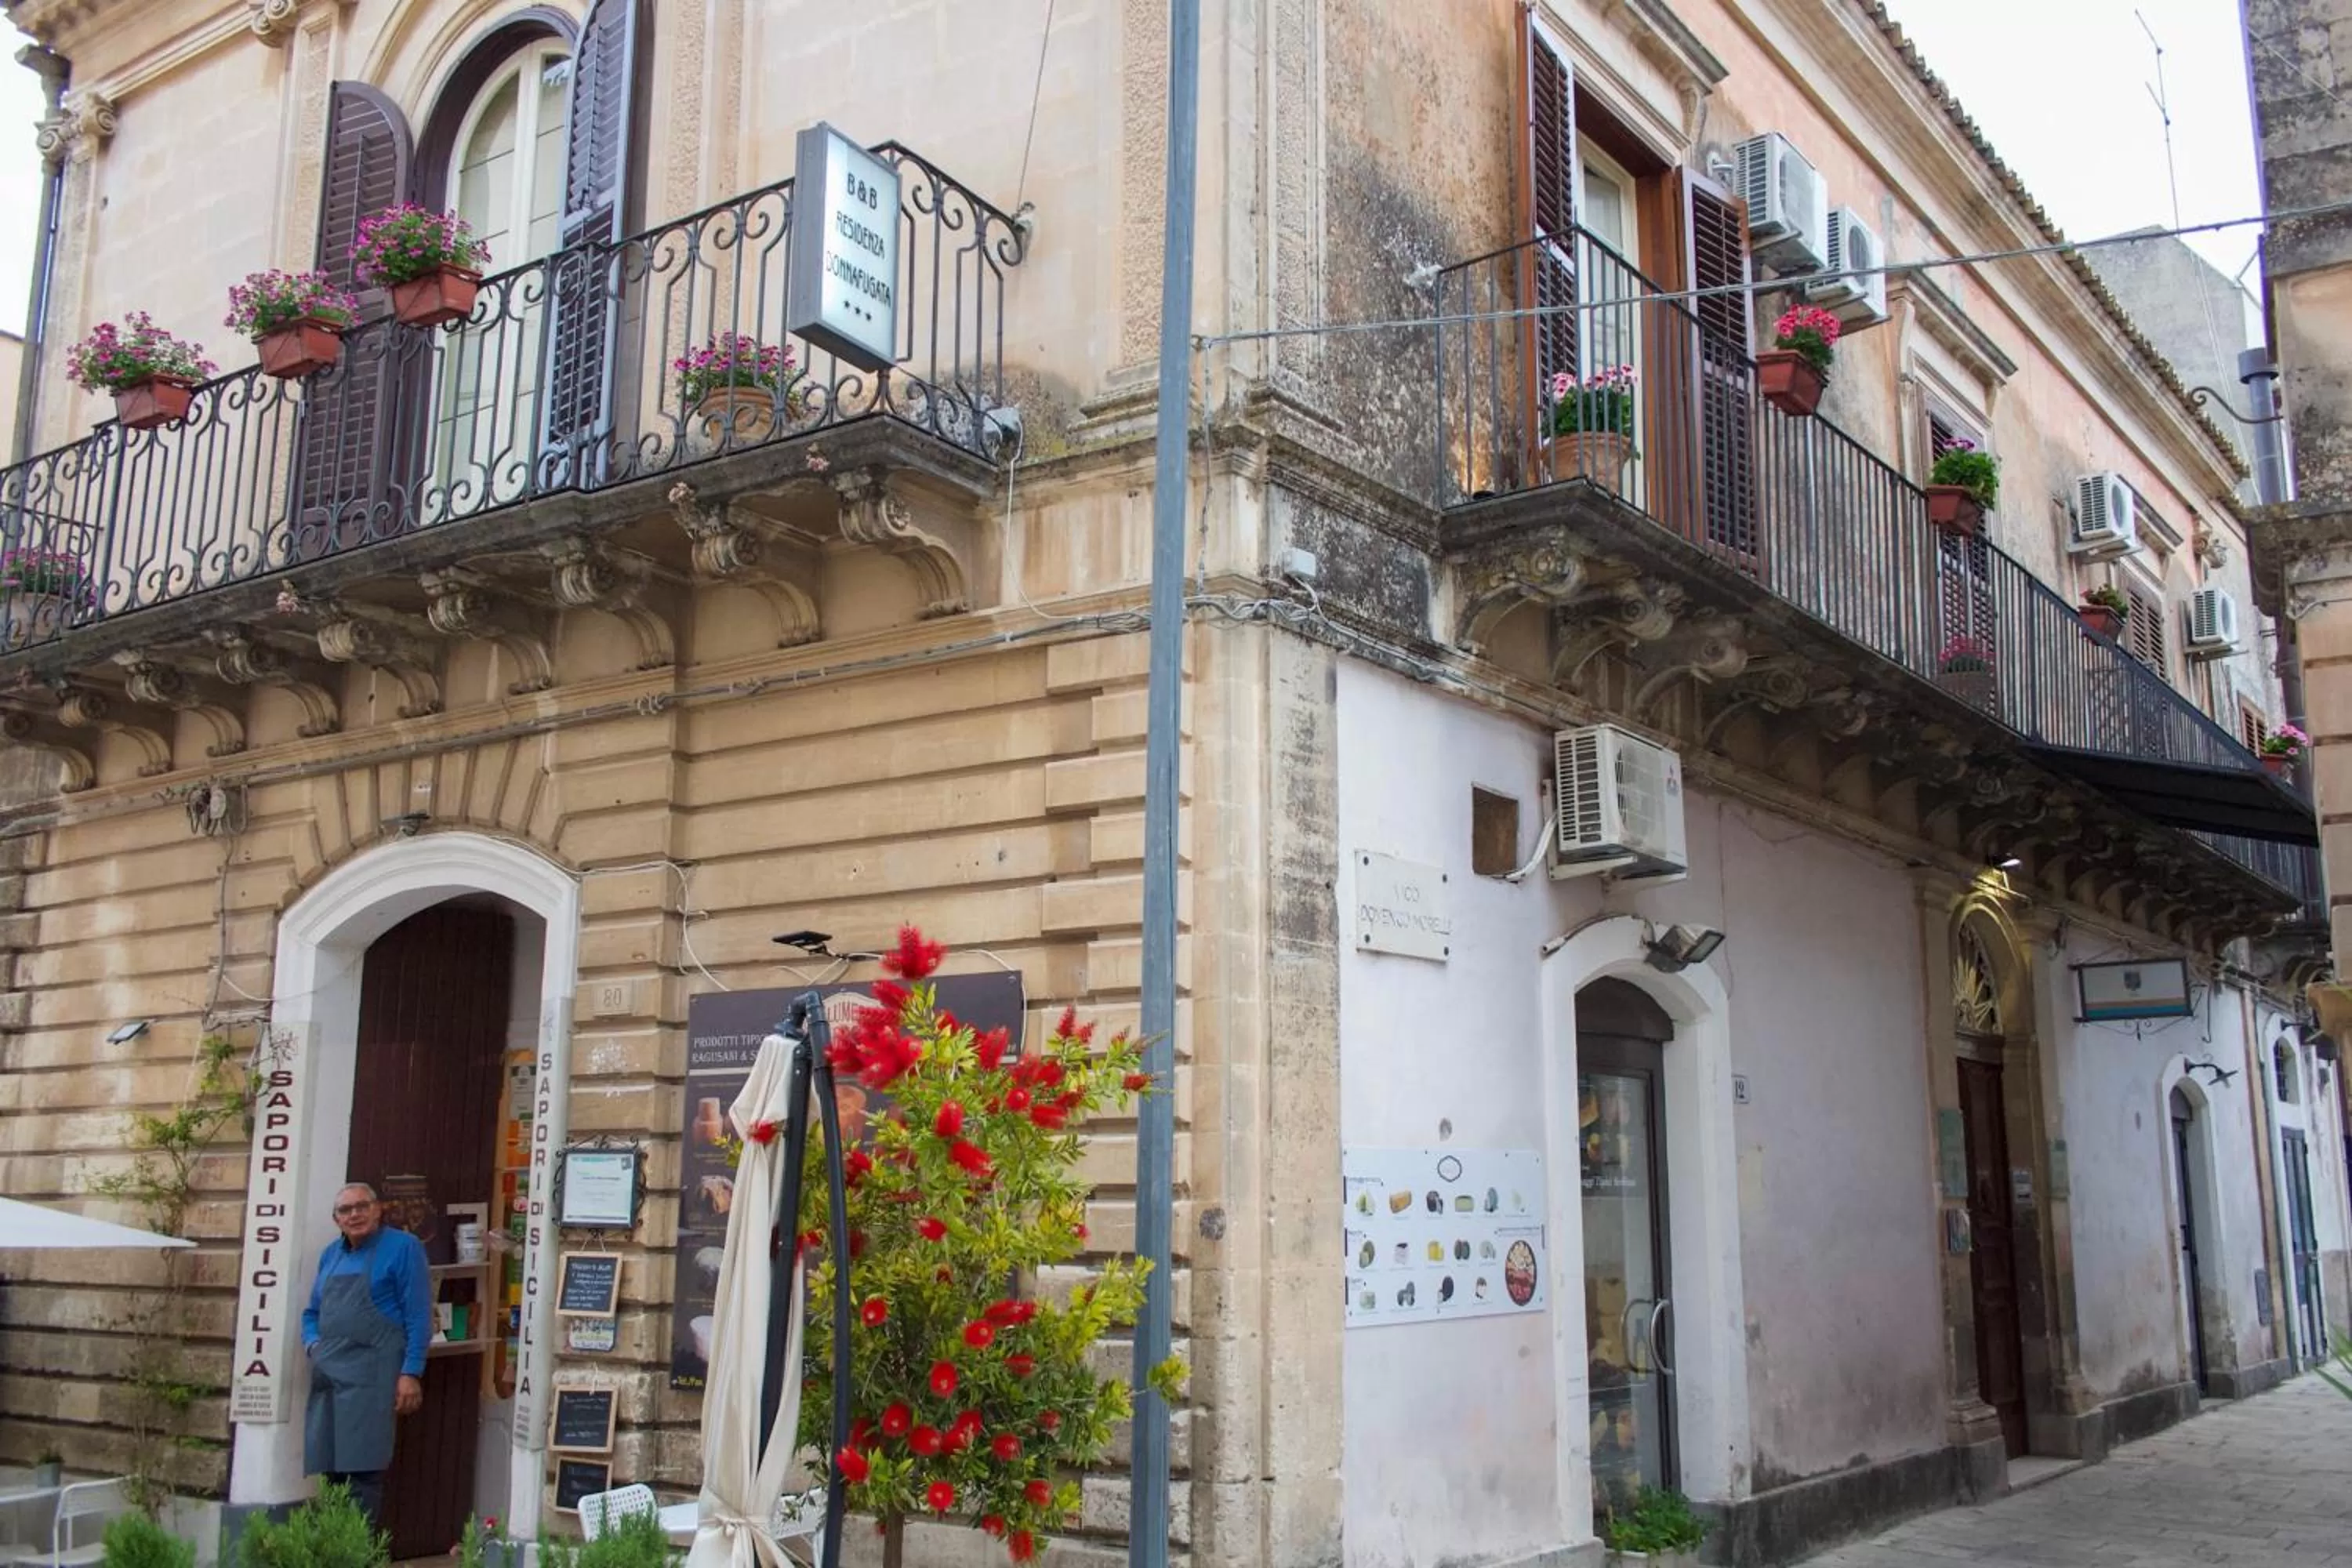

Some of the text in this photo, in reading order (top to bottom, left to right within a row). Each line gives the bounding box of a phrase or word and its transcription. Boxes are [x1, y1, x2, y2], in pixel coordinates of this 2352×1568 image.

[847, 172, 878, 210] B&B
[837, 210, 884, 260] RESIDENZA
[826, 251, 891, 308] DONNAFUGATA
[693, 1035, 738, 1049] PRODOTTI
[263, 1069, 293, 1196] SAPORI
[531, 1052, 554, 1191] SAPORI
[256, 1203, 285, 1218] DI
[530, 1200, 543, 1217] DI
[244, 1225, 281, 1377] SICILIA
[520, 1227, 541, 1396] SICILIA
